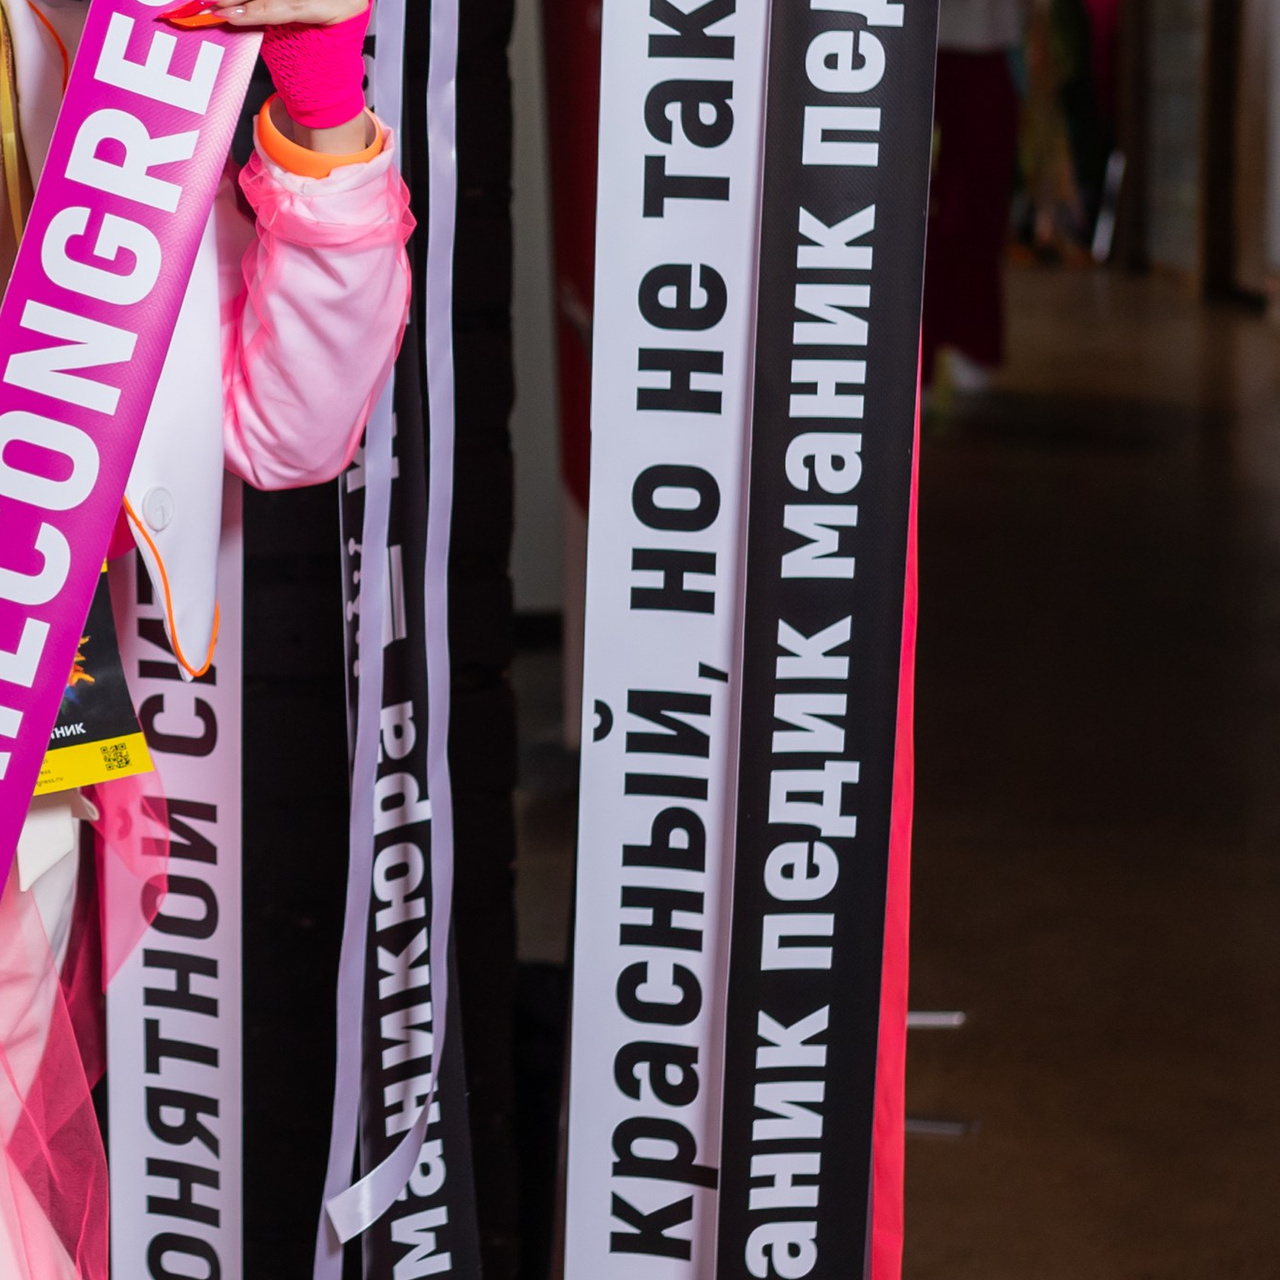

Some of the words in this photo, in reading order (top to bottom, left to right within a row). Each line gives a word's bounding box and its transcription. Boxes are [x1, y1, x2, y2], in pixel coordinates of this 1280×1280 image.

[636, 262, 728, 415] не
[780, 204, 876, 580] маник
[629, 463, 721, 615] но
[50, 722, 87, 740] ТНИК
[760, 615, 860, 971] педик
[593, 661, 729, 1261] красный,
